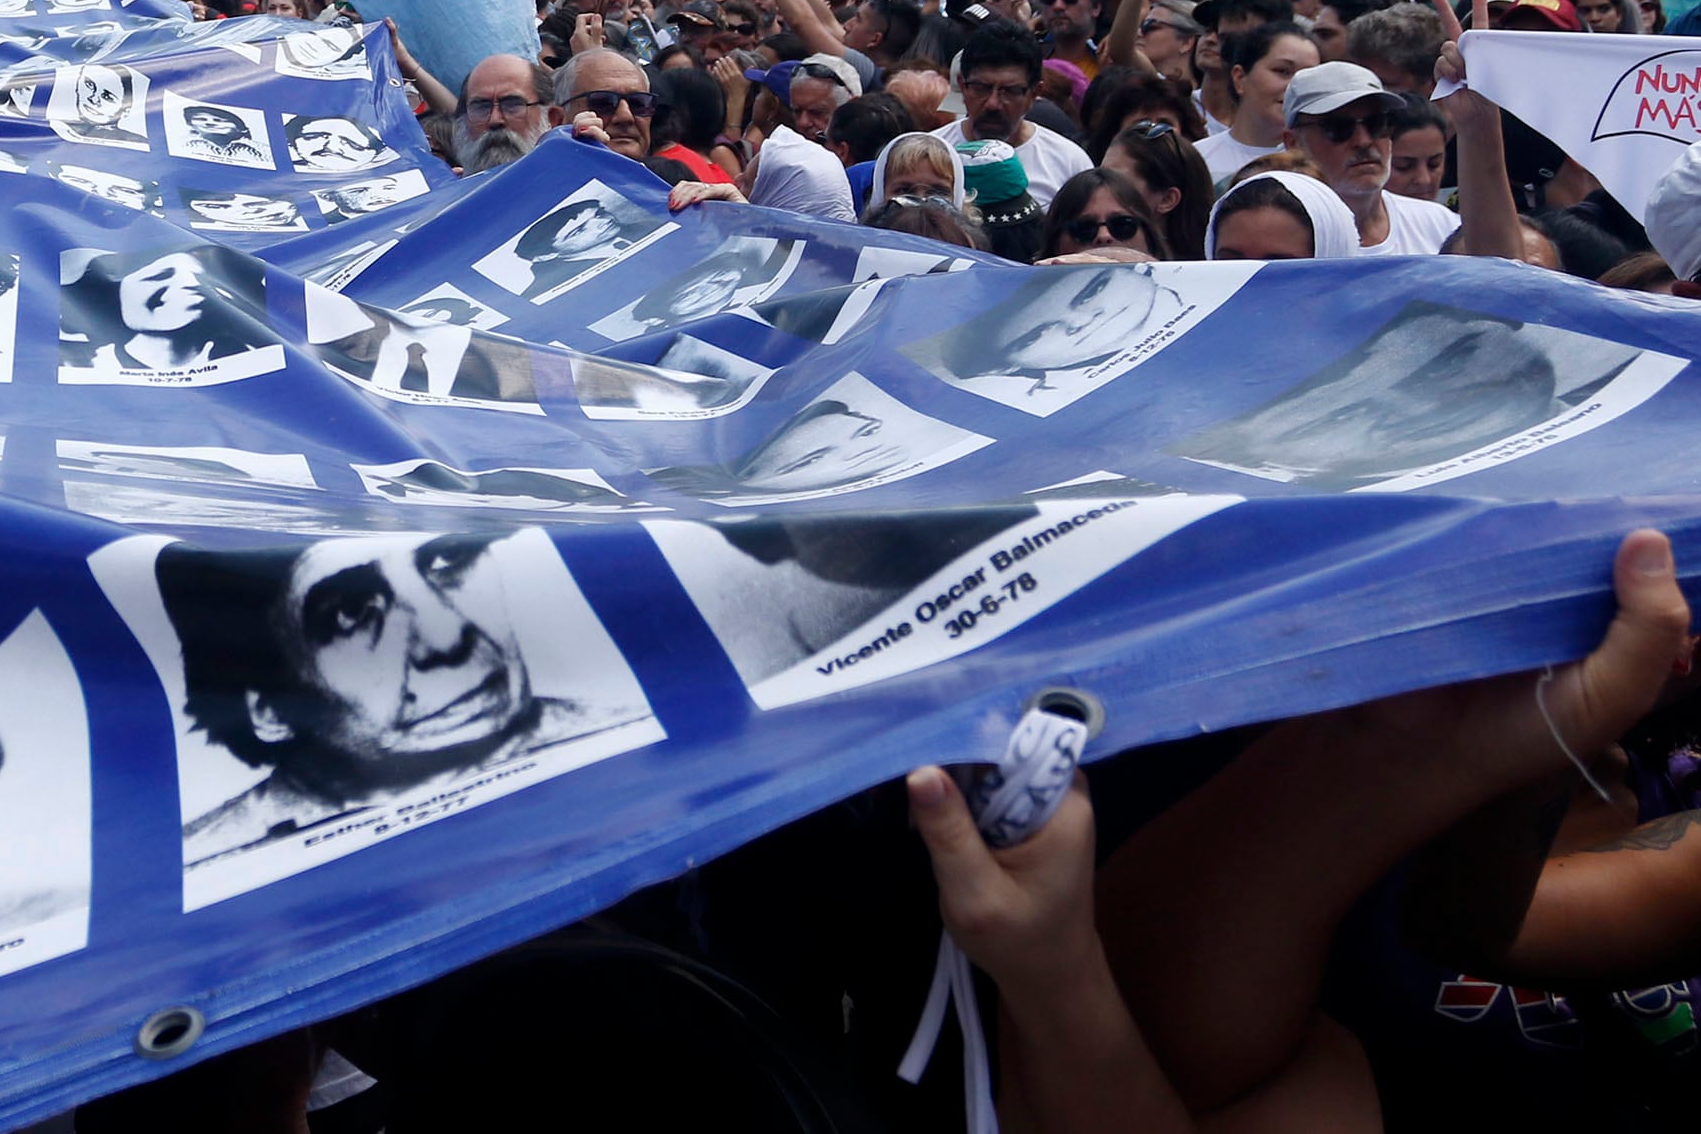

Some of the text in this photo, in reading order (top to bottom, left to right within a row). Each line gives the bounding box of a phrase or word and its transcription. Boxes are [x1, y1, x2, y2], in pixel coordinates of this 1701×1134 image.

[1133, 329, 1164, 352] Julio
[188, 364, 219, 375] Avila
[944, 571, 1039, 640] 30-6-78
[815, 619, 914, 678] Vicente
[915, 567, 987, 625] Oscar
[304, 815, 387, 847] Esther
